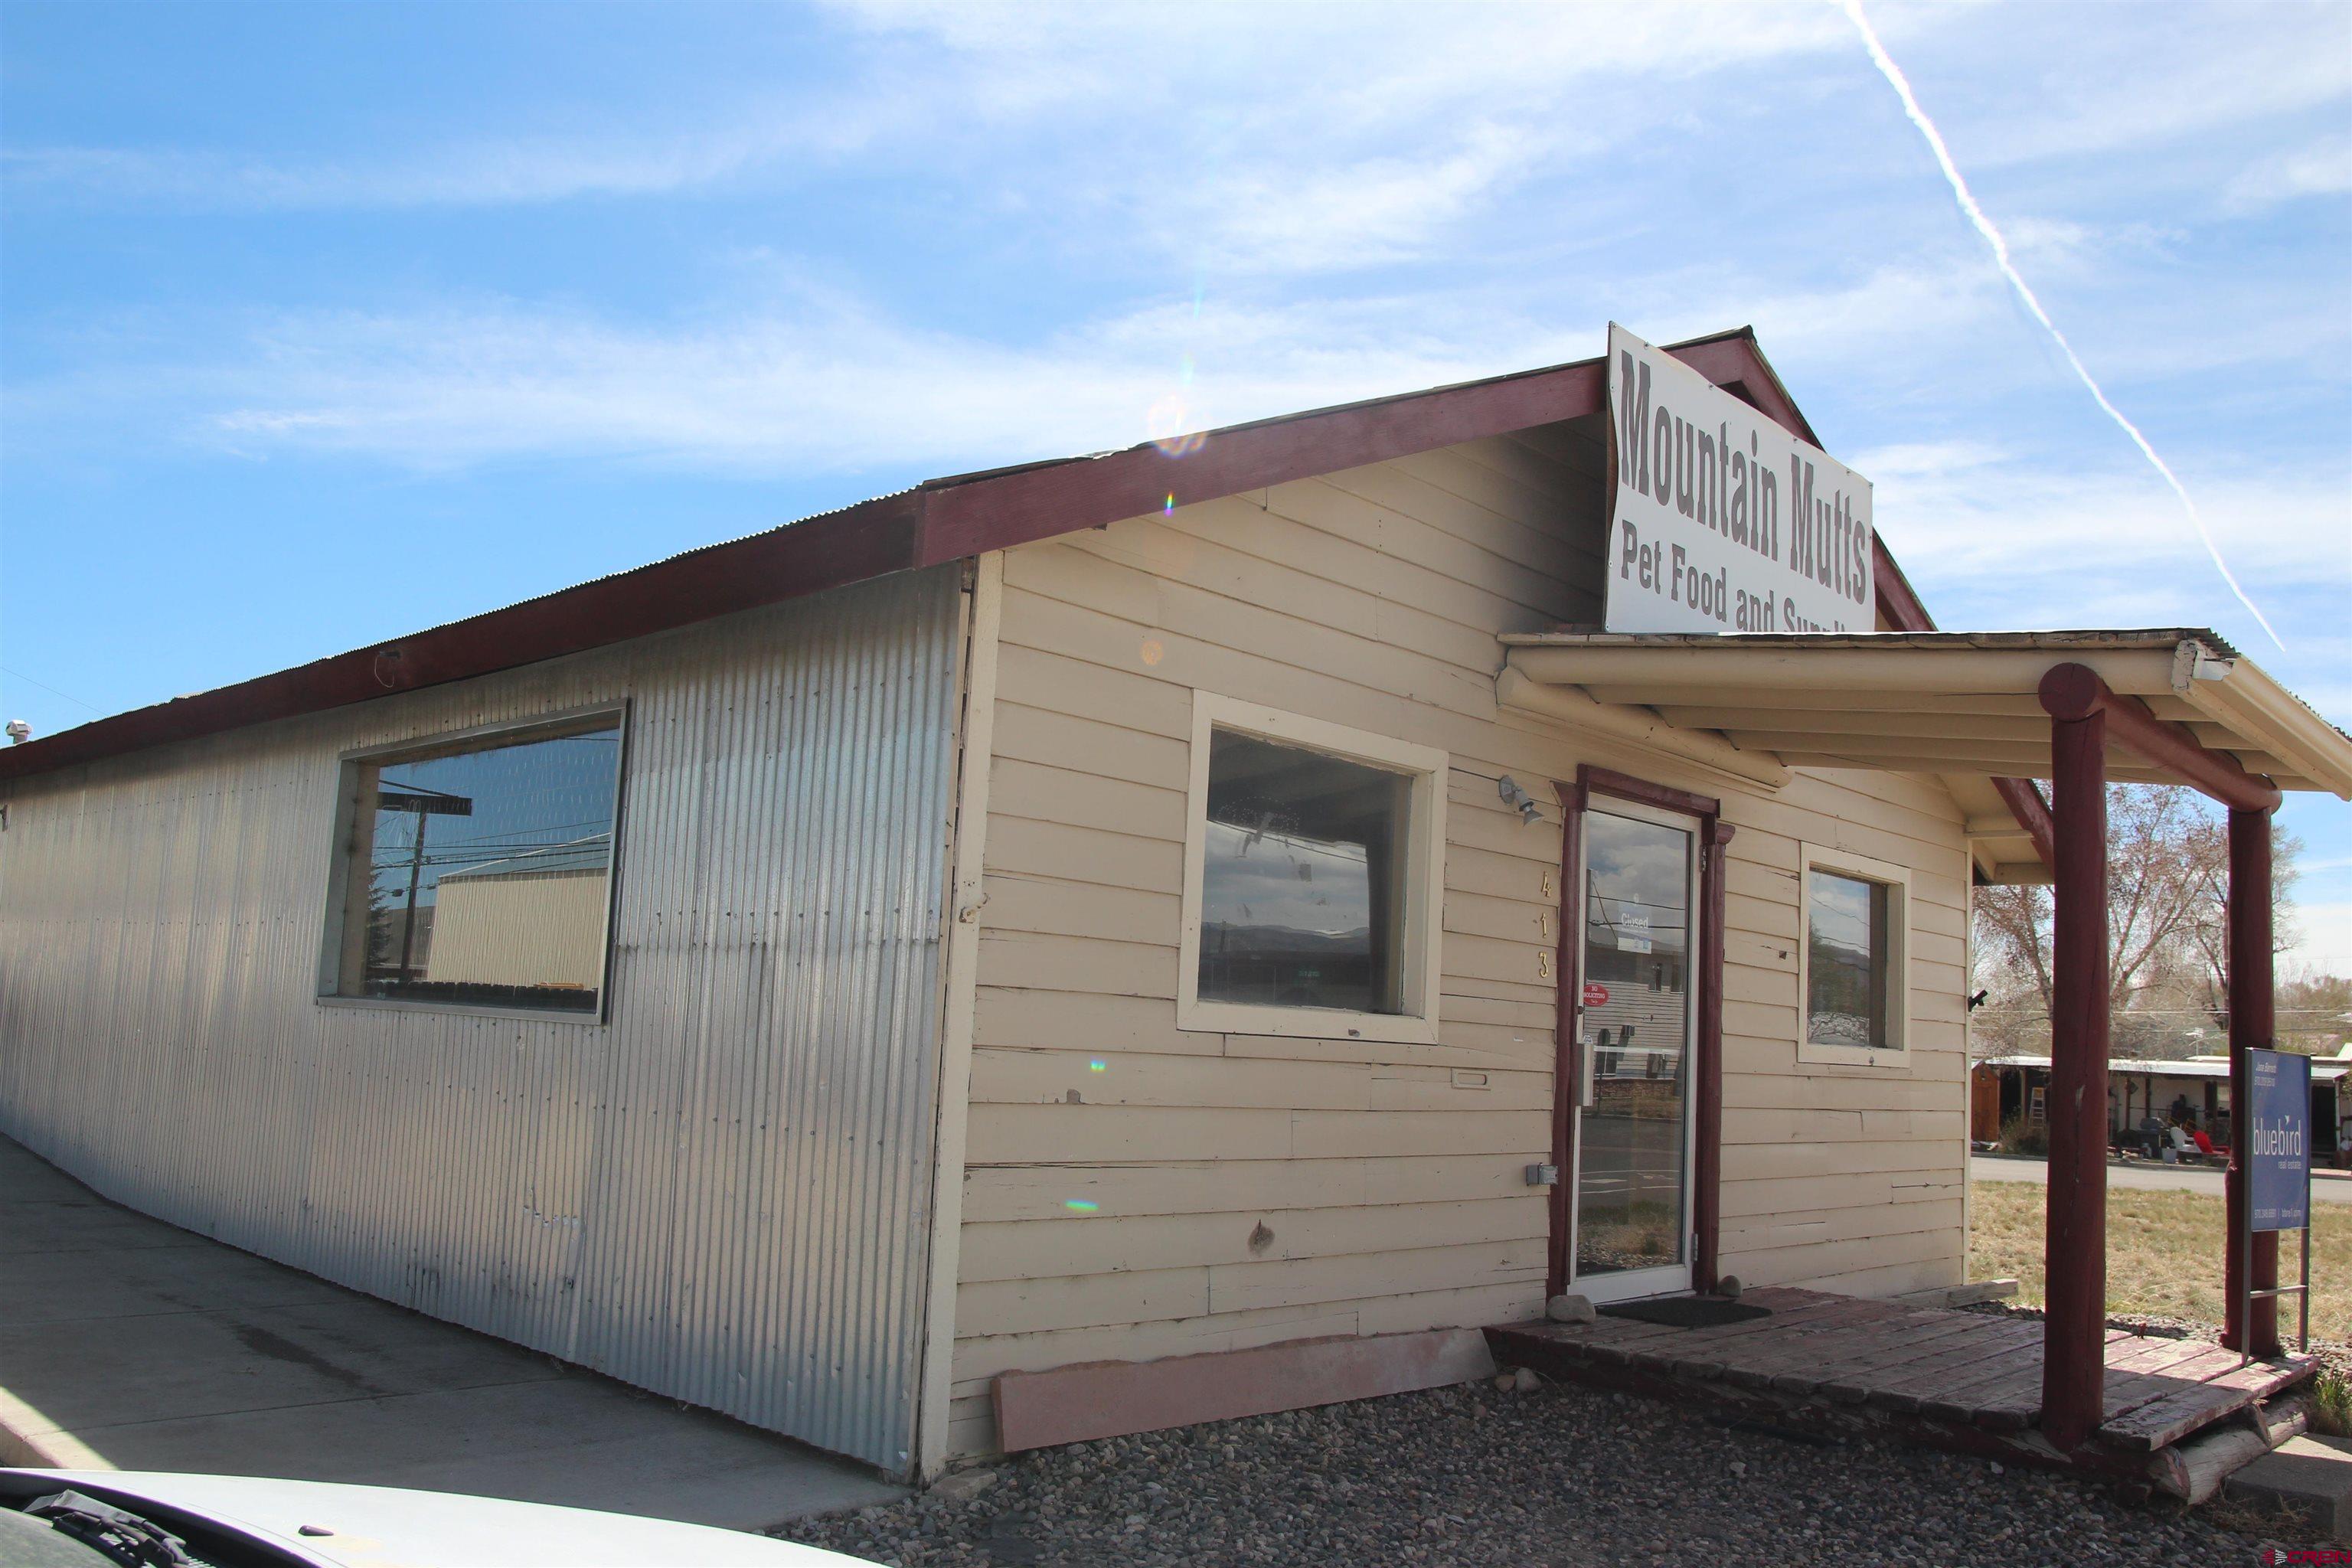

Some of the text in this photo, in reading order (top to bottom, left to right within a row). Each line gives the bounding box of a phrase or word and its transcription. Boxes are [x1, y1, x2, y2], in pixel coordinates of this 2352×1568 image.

[1621, 349, 1866, 605] Mountain Mutts
[1621, 519, 1661, 594] Pet
[1671, 543, 1727, 622] Food
[1736, 589, 1775, 632] and
[1621, 913, 1648, 929] Closed
[2253, 1116, 2301, 1156] bluebird
[2278, 1159, 2287, 1170] real
